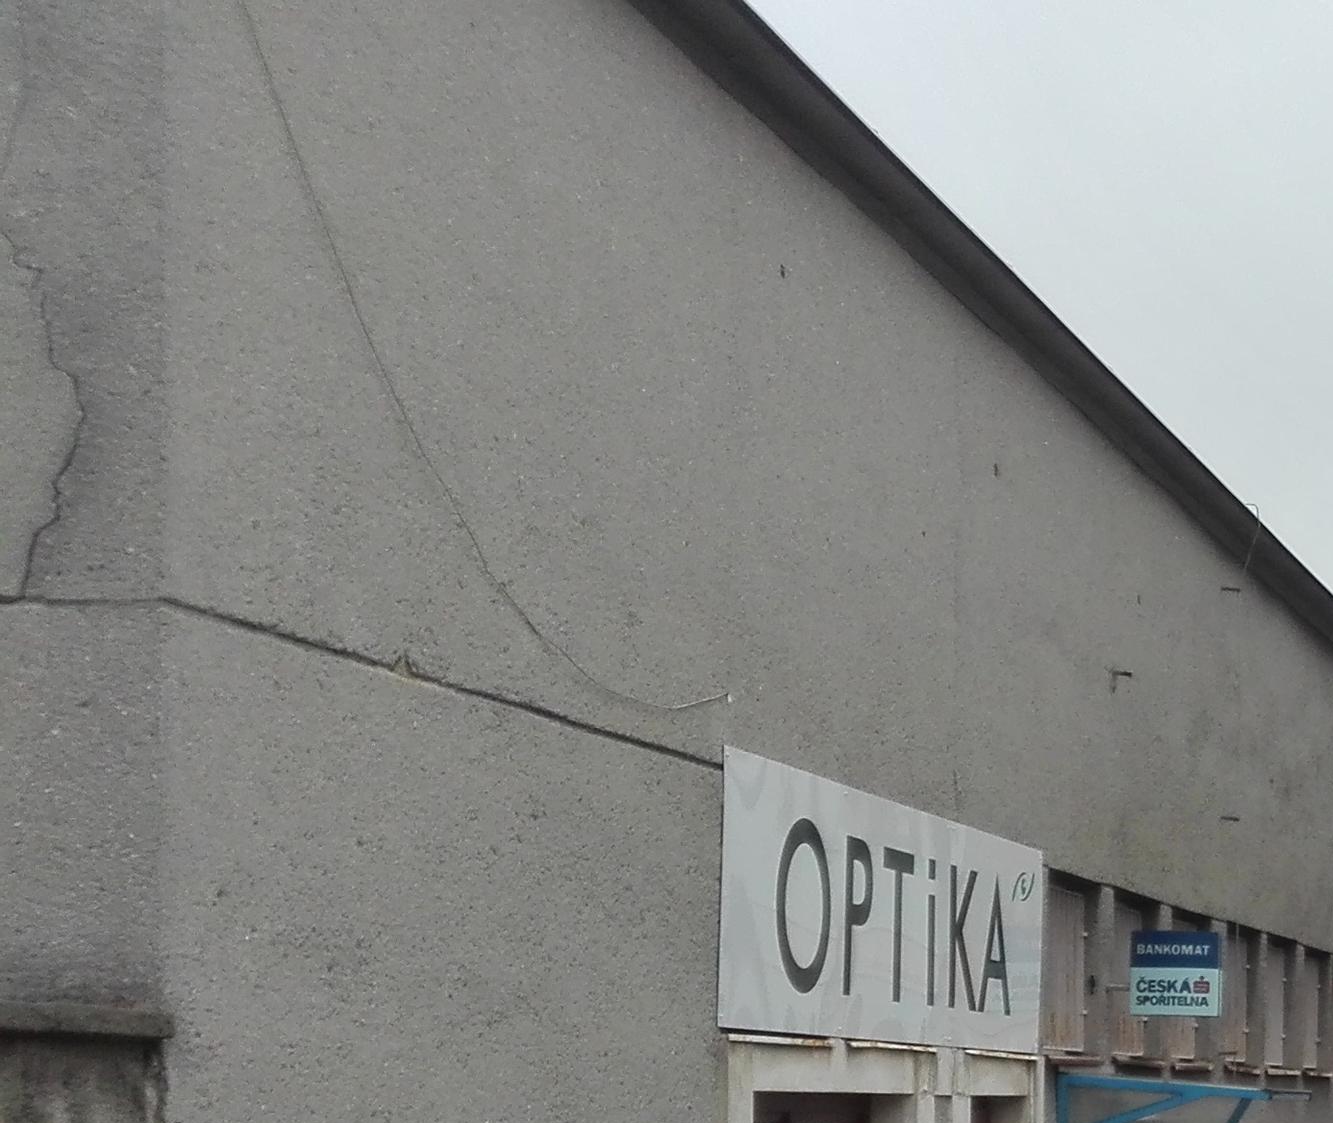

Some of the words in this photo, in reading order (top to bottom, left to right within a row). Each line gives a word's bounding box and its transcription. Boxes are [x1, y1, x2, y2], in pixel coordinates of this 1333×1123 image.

[1136, 943, 1210, 956] BANKOMAT
[1136, 976, 1192, 994] ČESKÁ
[1136, 995, 1209, 1007] SPOŘITELNA
